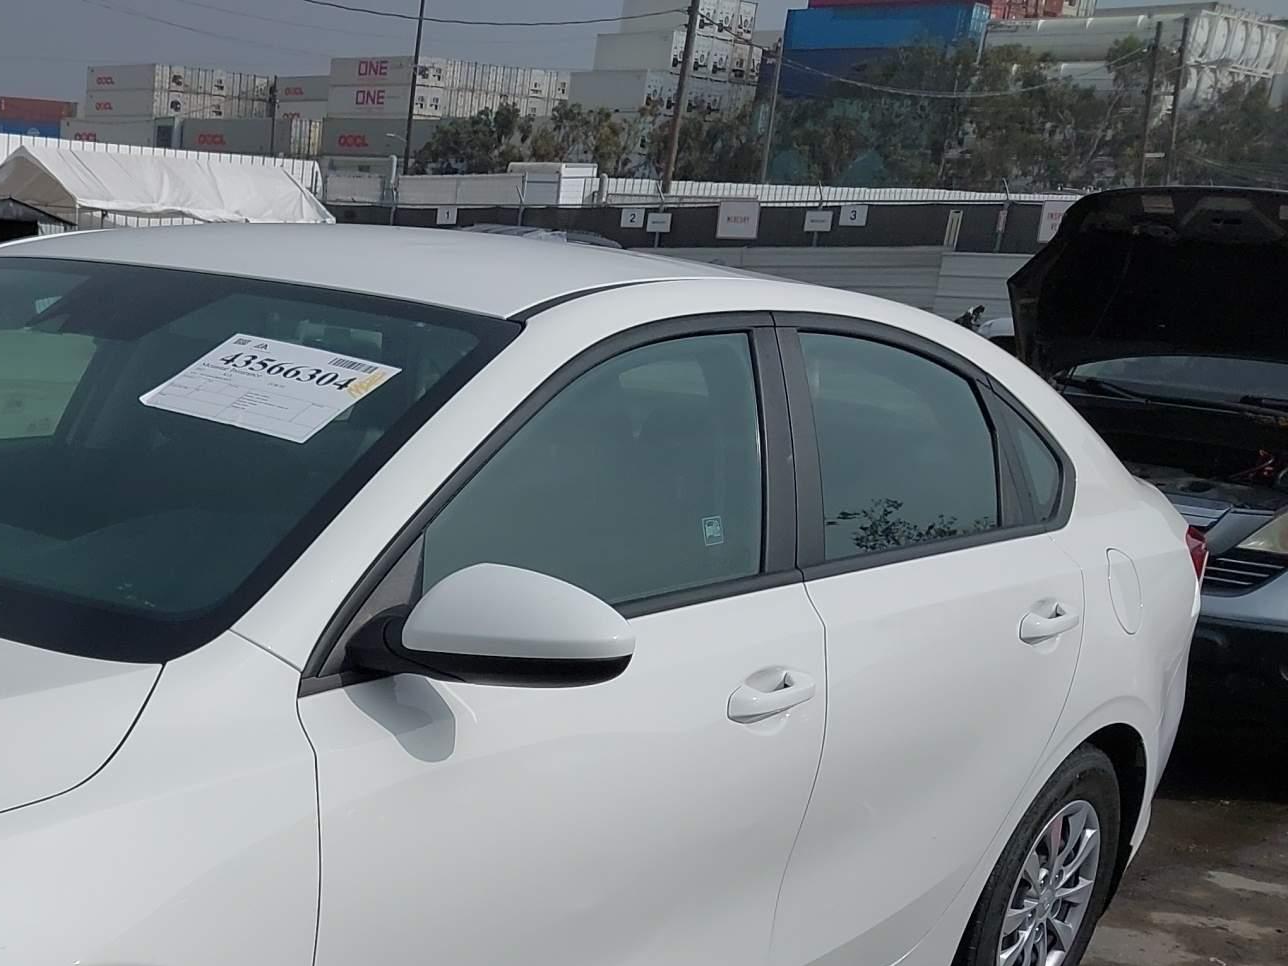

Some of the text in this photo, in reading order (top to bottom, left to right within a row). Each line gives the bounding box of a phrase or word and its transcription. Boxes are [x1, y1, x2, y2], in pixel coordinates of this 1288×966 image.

[358, 61, 388, 76] ONE
[355, 90, 385, 105] ONE
[338, 134, 368, 148] OOCL
[630, 213, 636, 223] 2
[849, 210, 857, 221] 3
[220, 352, 357, 391] 43566304
